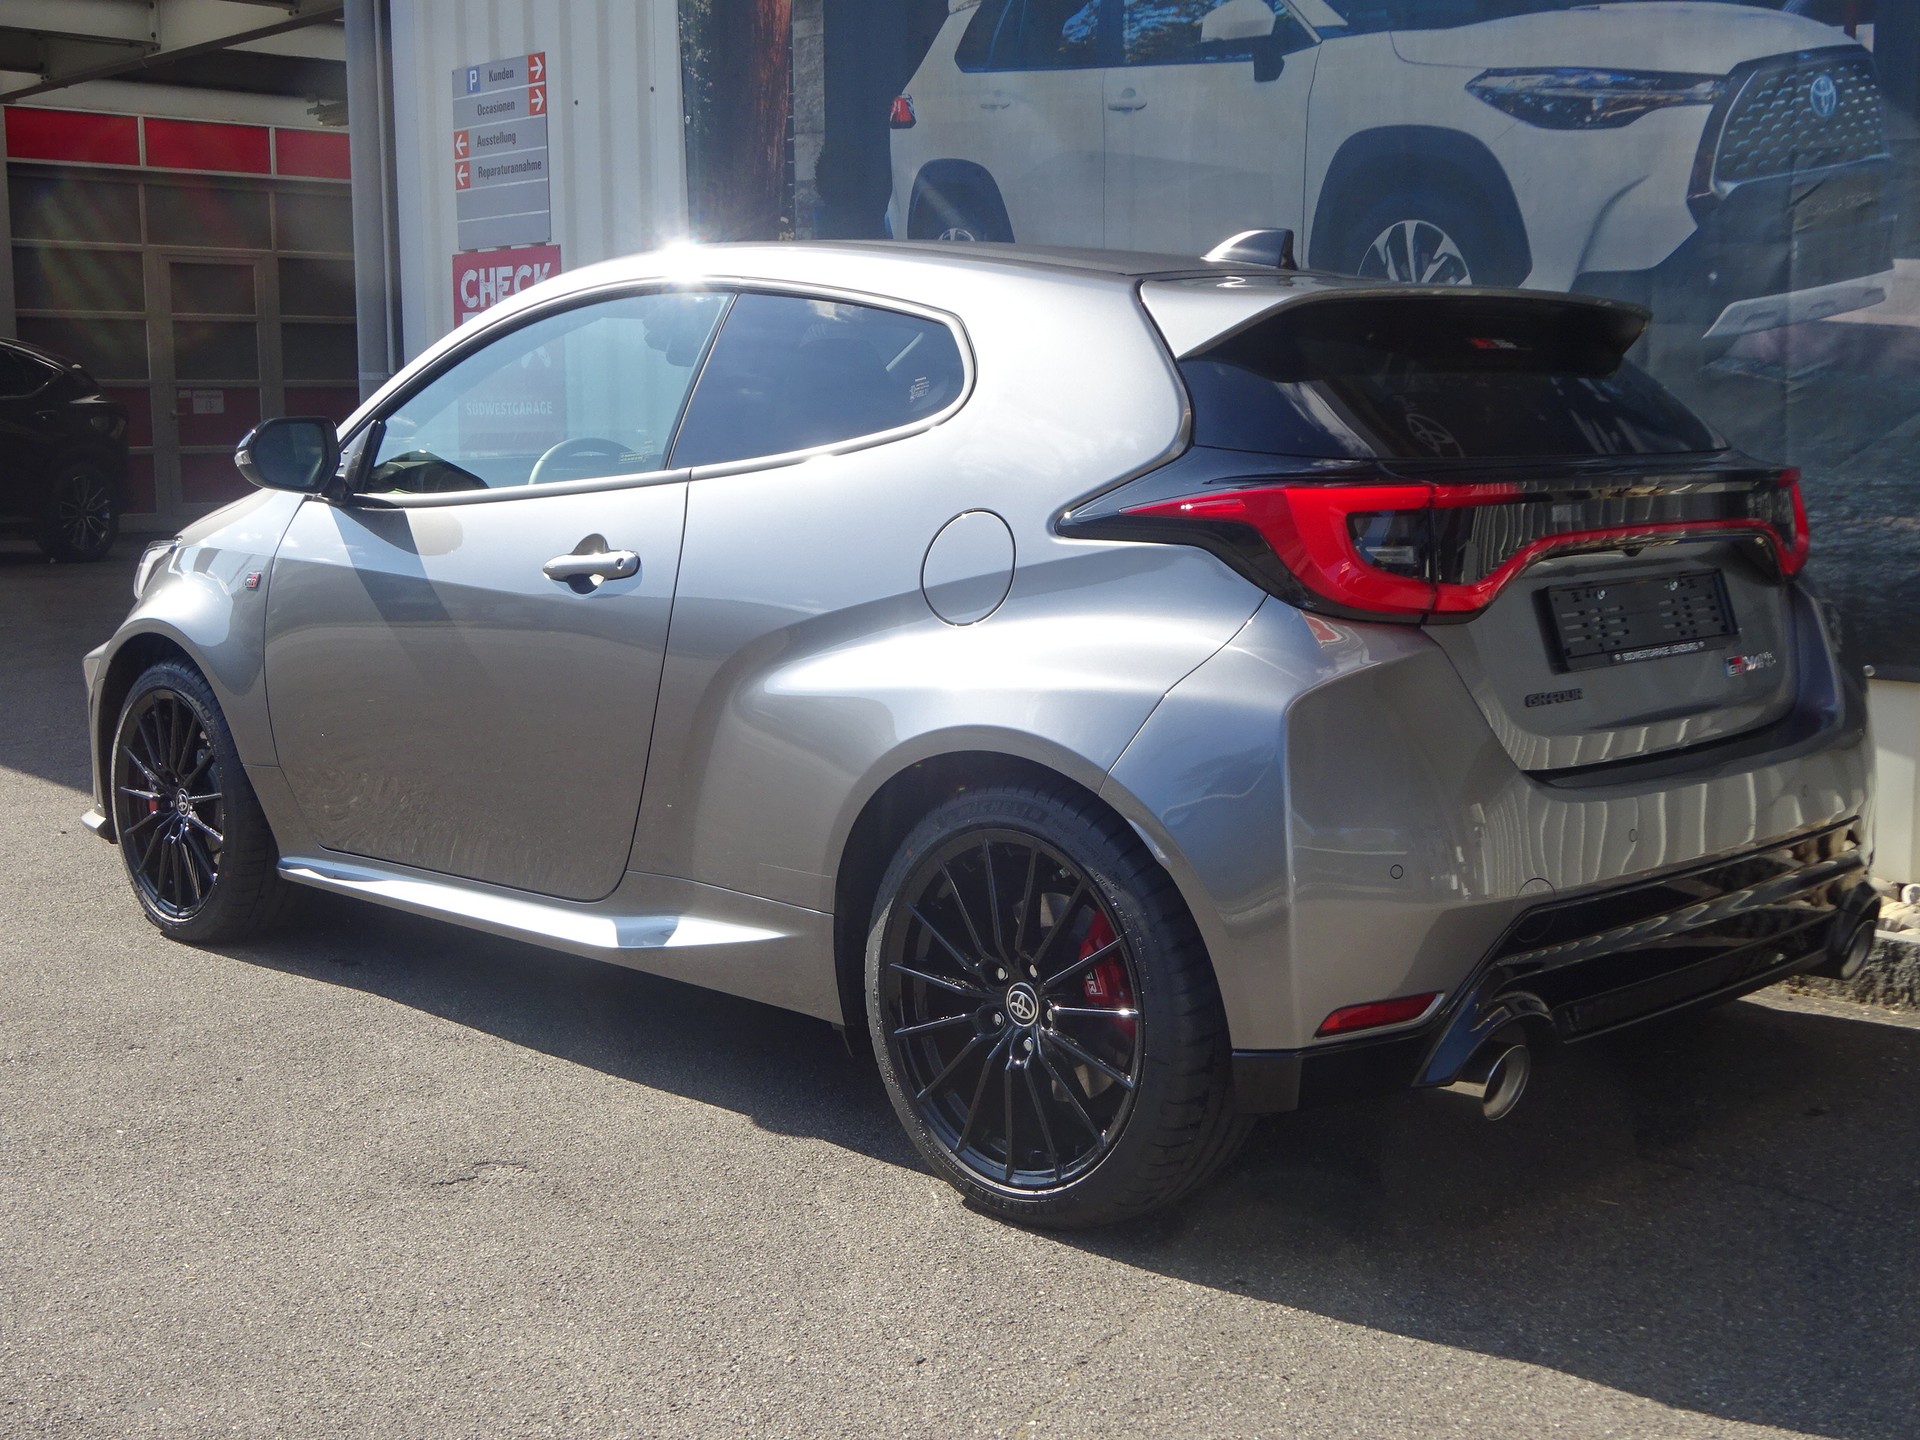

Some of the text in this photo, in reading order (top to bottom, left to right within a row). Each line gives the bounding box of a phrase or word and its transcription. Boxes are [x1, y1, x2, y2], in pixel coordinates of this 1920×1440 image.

[488, 68, 514, 82] Kunden
[477, 101, 515, 116] Occasionen
[477, 131, 516, 148] Ausstellung
[478, 160, 542, 179] Reparaturannahme
[466, 400, 553, 416] SÜDWESTGARAGE
